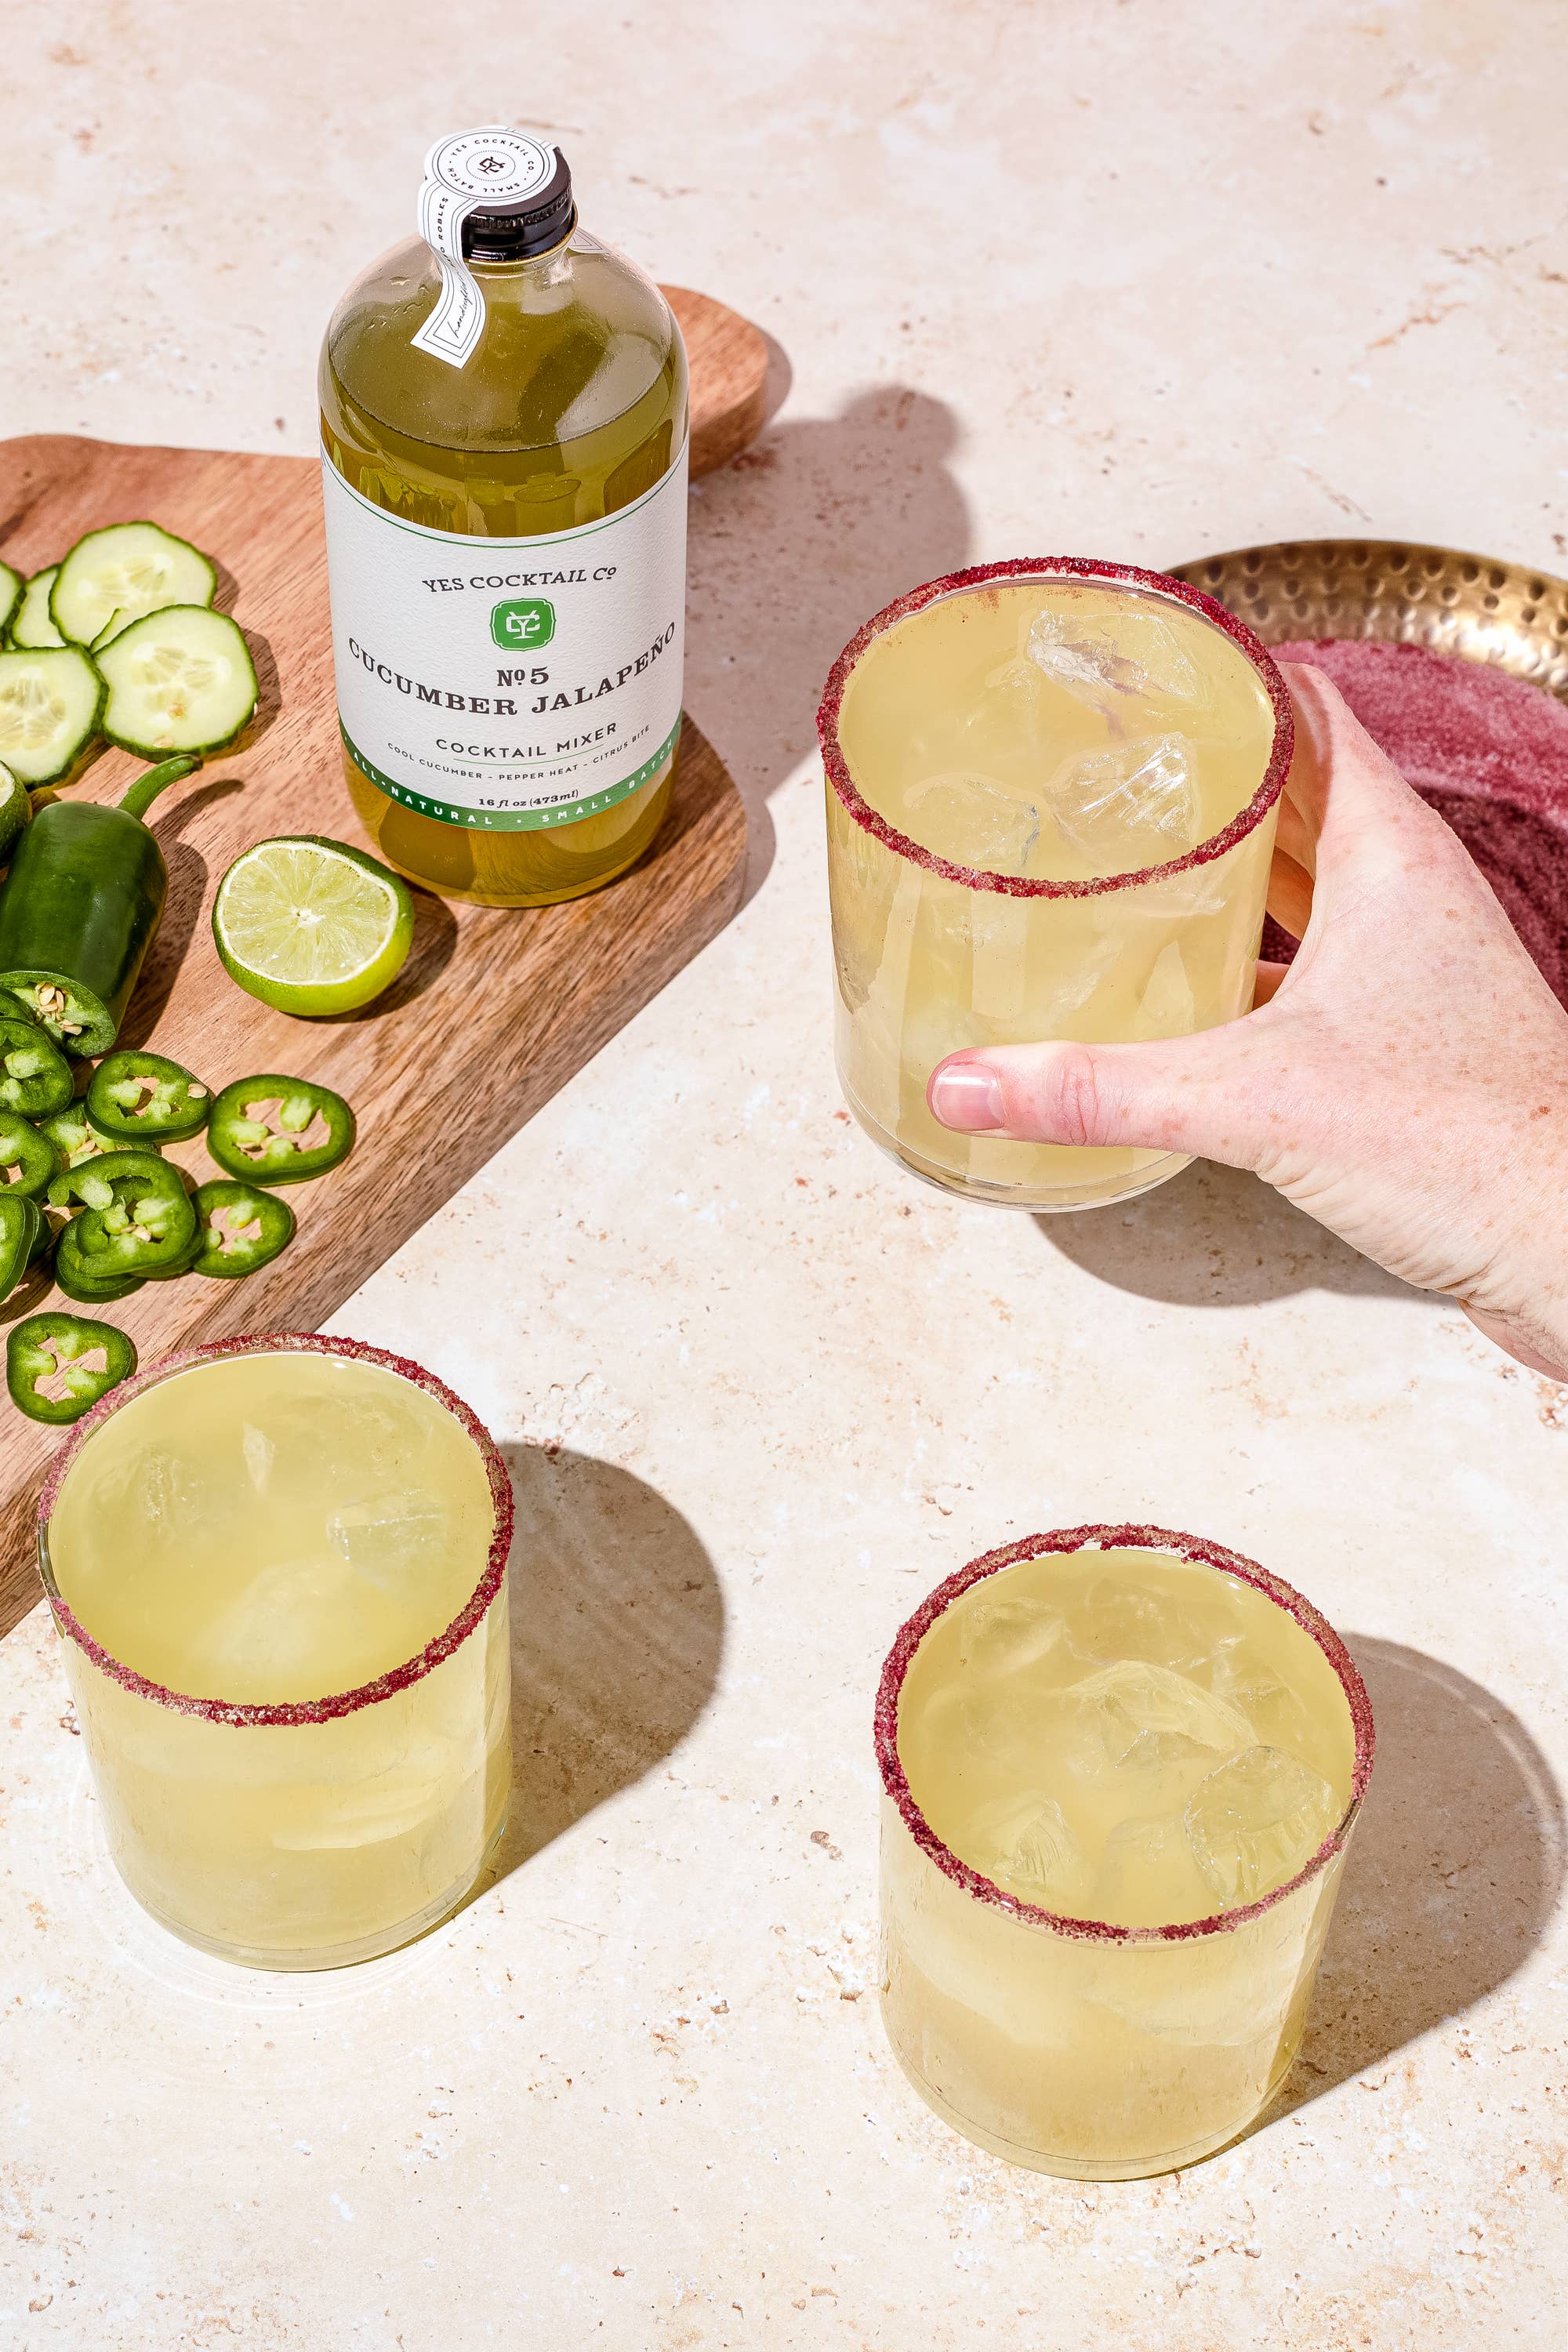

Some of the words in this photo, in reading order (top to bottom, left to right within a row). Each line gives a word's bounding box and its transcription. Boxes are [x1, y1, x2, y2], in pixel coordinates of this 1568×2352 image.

[451, 144, 467, 156] YES
[474, 139, 528, 156] COCKTAIL
[448, 168, 474, 190] BATCH
[483, 183, 520, 193] SMALL
[437, 198, 449, 241] ROBLES
[422, 578, 465, 593] YES
[470, 569, 587, 589] COCKTAIL
[348, 637, 517, 716] CUCUMBER
[532, 621, 675, 714] JALAPEÑO
[387, 742, 415, 761] COOL
[419, 758, 482, 779] CUCUMBER
[499, 772, 544, 781] PEPPER
[550, 764, 579, 777] HEAT
[593, 741, 628, 764] CITRUS
[632, 724, 650, 743] BITE
[436, 739, 546, 758] COCKTAIL
[557, 722, 617, 753] MIXER
[542, 795, 612, 822] SMALL
[628, 739, 673, 789] BATCH
[478, 798, 495, 807] 16
[496, 798, 509, 808] fl
[529, 789, 579, 808] (473ml)
